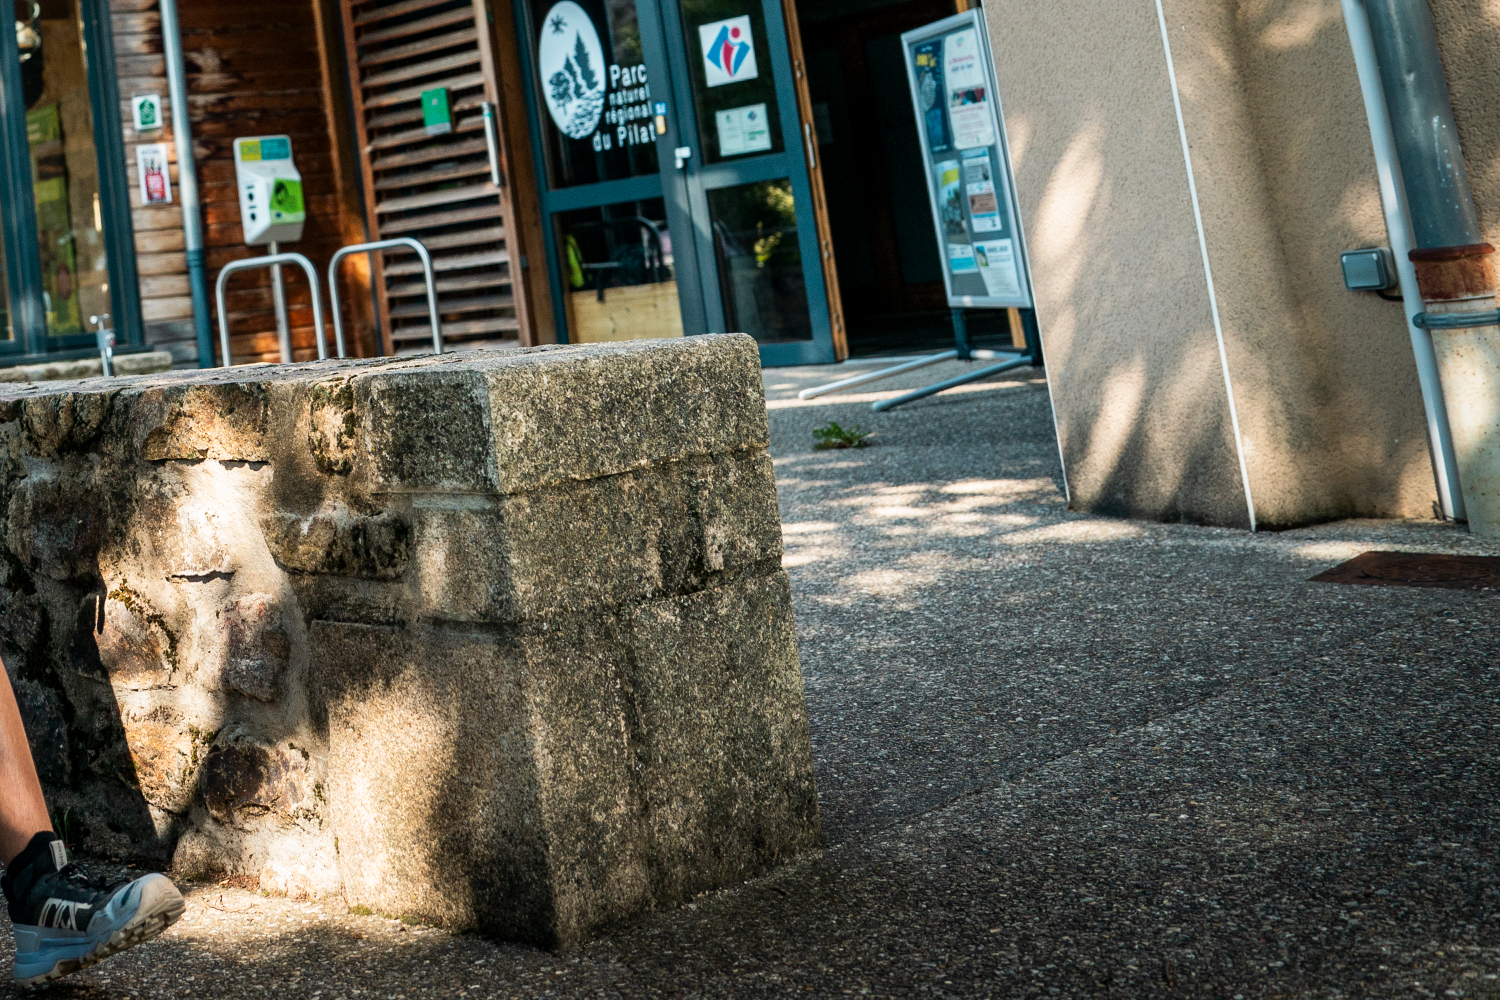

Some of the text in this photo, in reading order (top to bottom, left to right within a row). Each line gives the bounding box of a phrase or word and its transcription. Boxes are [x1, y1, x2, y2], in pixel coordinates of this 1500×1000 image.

[610, 64, 647, 88] Parc
[610, 83, 650, 105] naturel
[606, 100, 653, 126] régional
[593, 122, 656, 152] du Pilat
